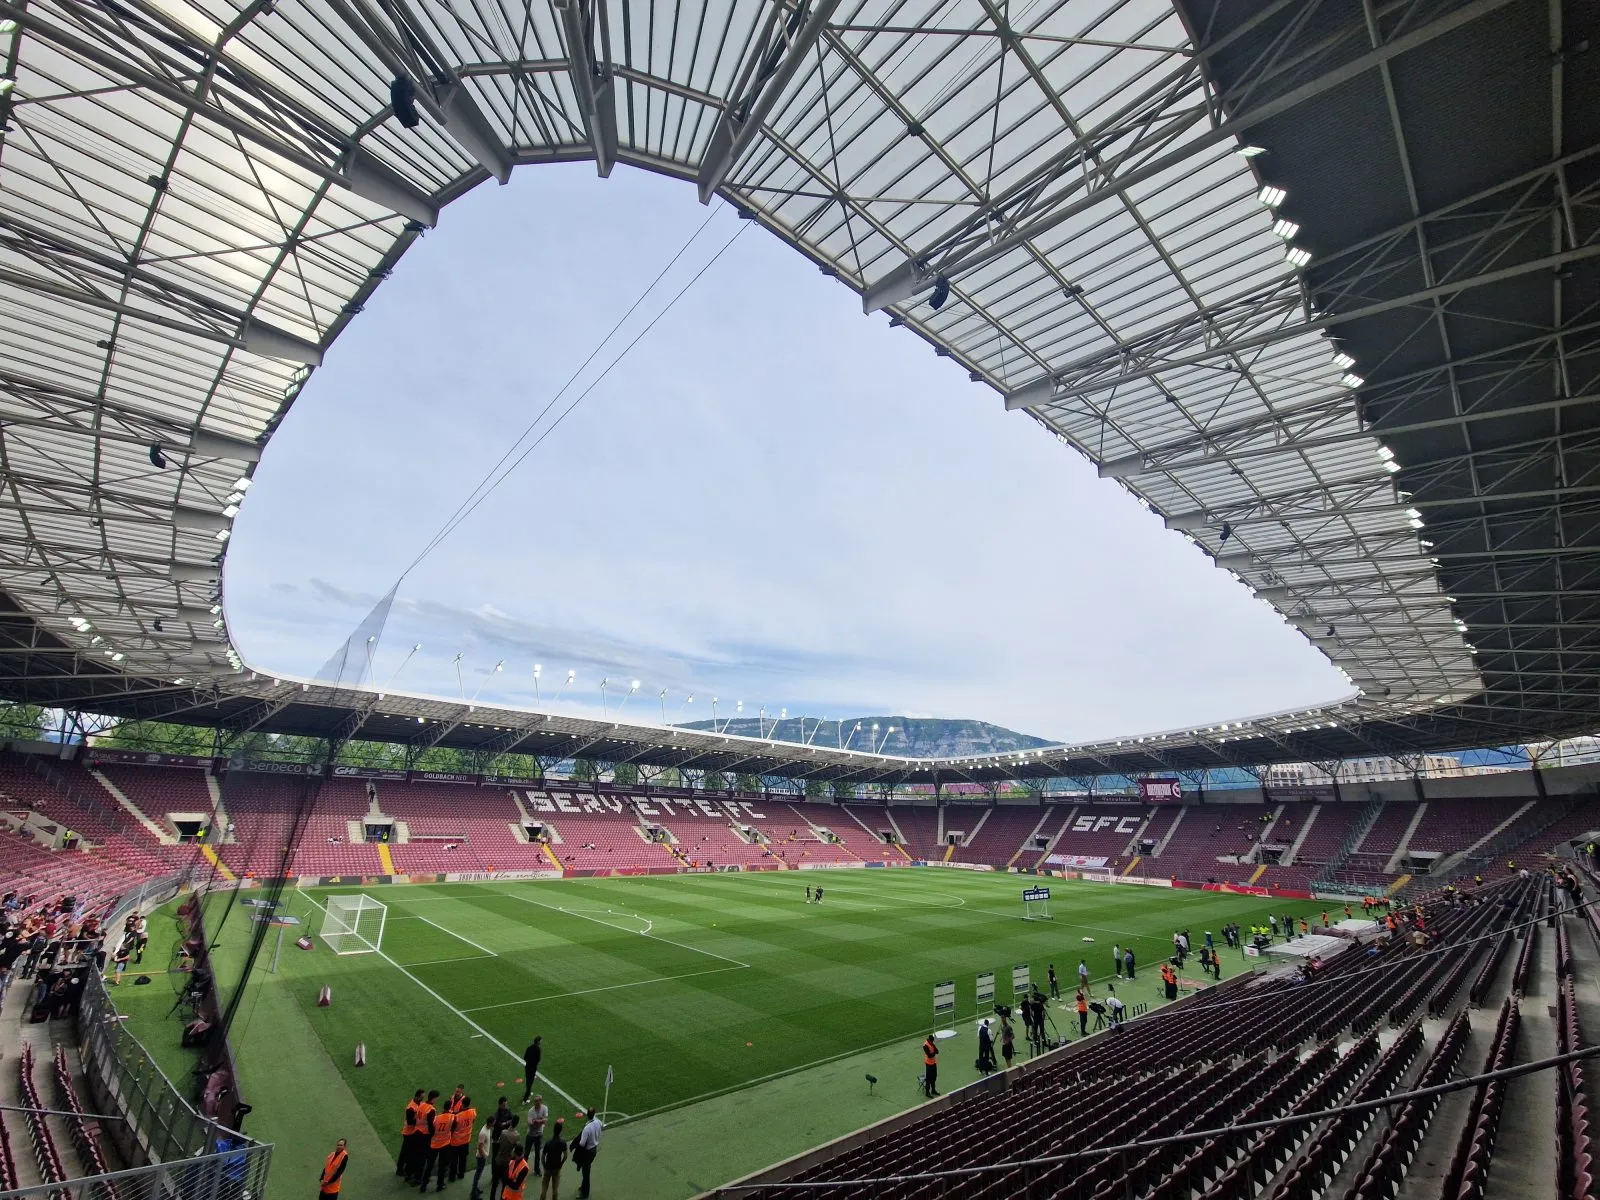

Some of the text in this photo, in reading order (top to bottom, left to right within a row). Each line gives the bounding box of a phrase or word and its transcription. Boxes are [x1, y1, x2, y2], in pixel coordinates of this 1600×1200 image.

[248, 760, 301, 772] Serbeco
[423, 772, 455, 780] GOLDBACH
[1072, 816, 1141, 833] SFC
